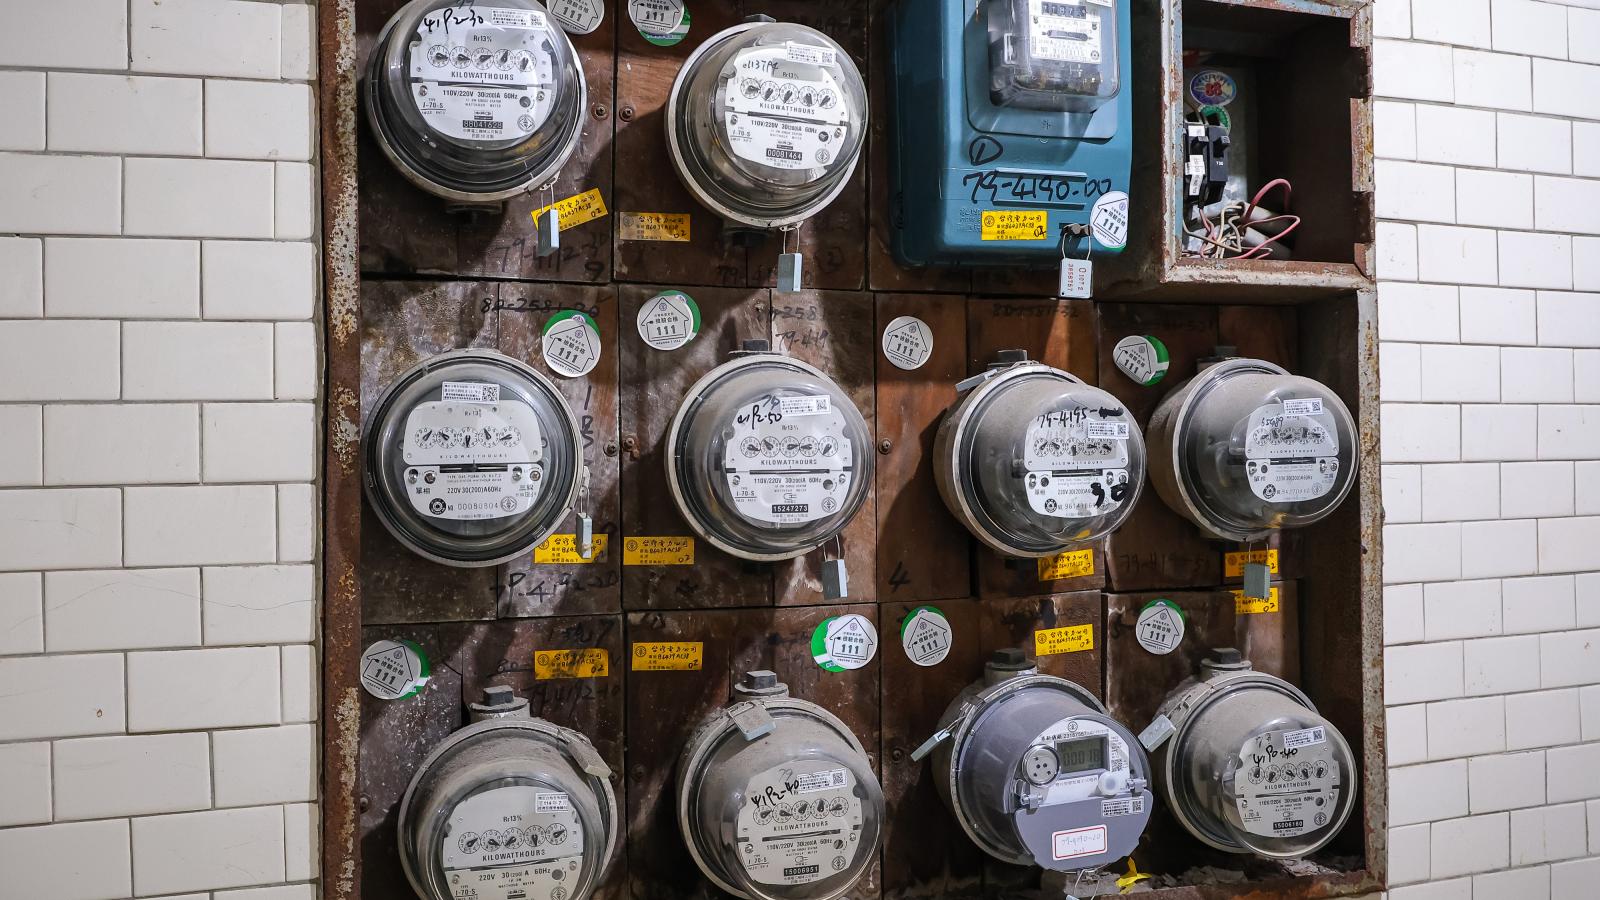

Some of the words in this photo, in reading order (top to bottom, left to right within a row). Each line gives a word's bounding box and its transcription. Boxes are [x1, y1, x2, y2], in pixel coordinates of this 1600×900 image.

[563, 6, 582, 21] 111
[645, 10, 665, 22] 111
[451, 71, 514, 80] KILOWATTHOURS
[760, 103, 815, 115] KILOWATTHOURS
[1103, 219, 1120, 235] 111
[656, 325, 675, 335] 111
[558, 347, 579, 363] 111
[897, 343, 913, 356] 111
[1124, 360, 1139, 373] 111
[1150, 630, 1166, 642] 111
[842, 644, 859, 654] 111
[921, 639, 938, 654] 111
[375, 669, 396, 685] 111
[1265, 781, 1311, 790] KILOWATTHOURS
[774, 821, 829, 832] KILOWATTHOURS
[482, 849, 546, 862] KILOWATTHOURS
[534, 868, 551, 876] 60Hz
